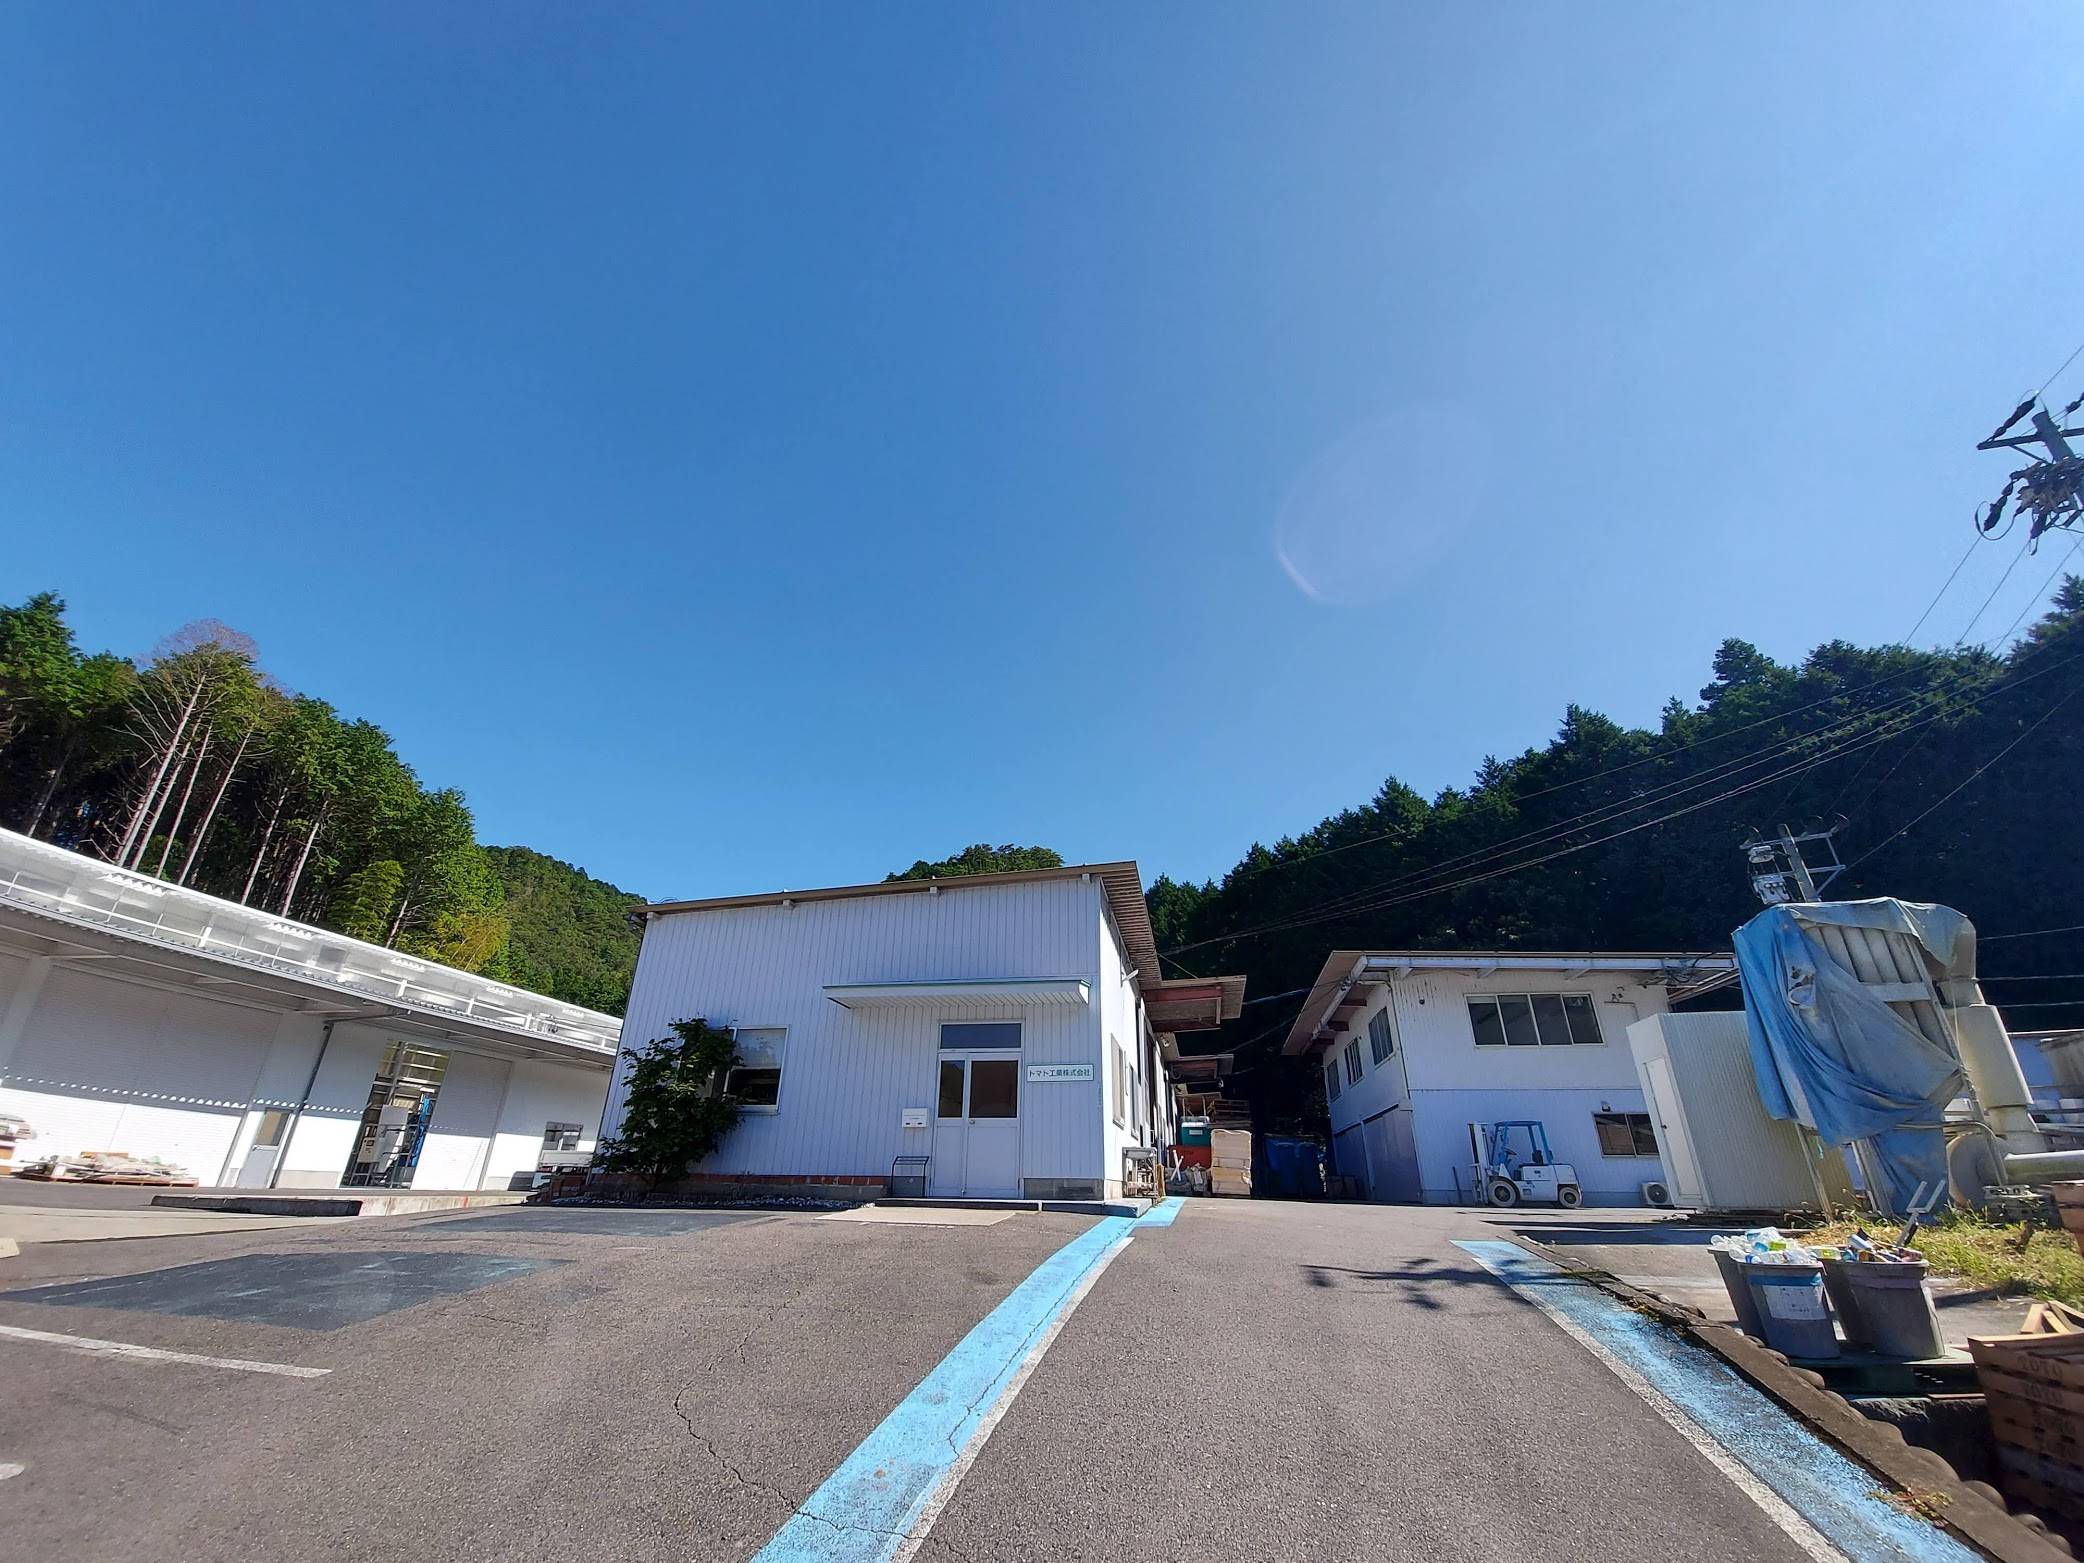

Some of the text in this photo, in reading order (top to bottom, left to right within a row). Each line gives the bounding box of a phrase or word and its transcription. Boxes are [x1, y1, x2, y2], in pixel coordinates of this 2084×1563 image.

[1029, 1068, 1091, 1078] トマト工業株式会社
